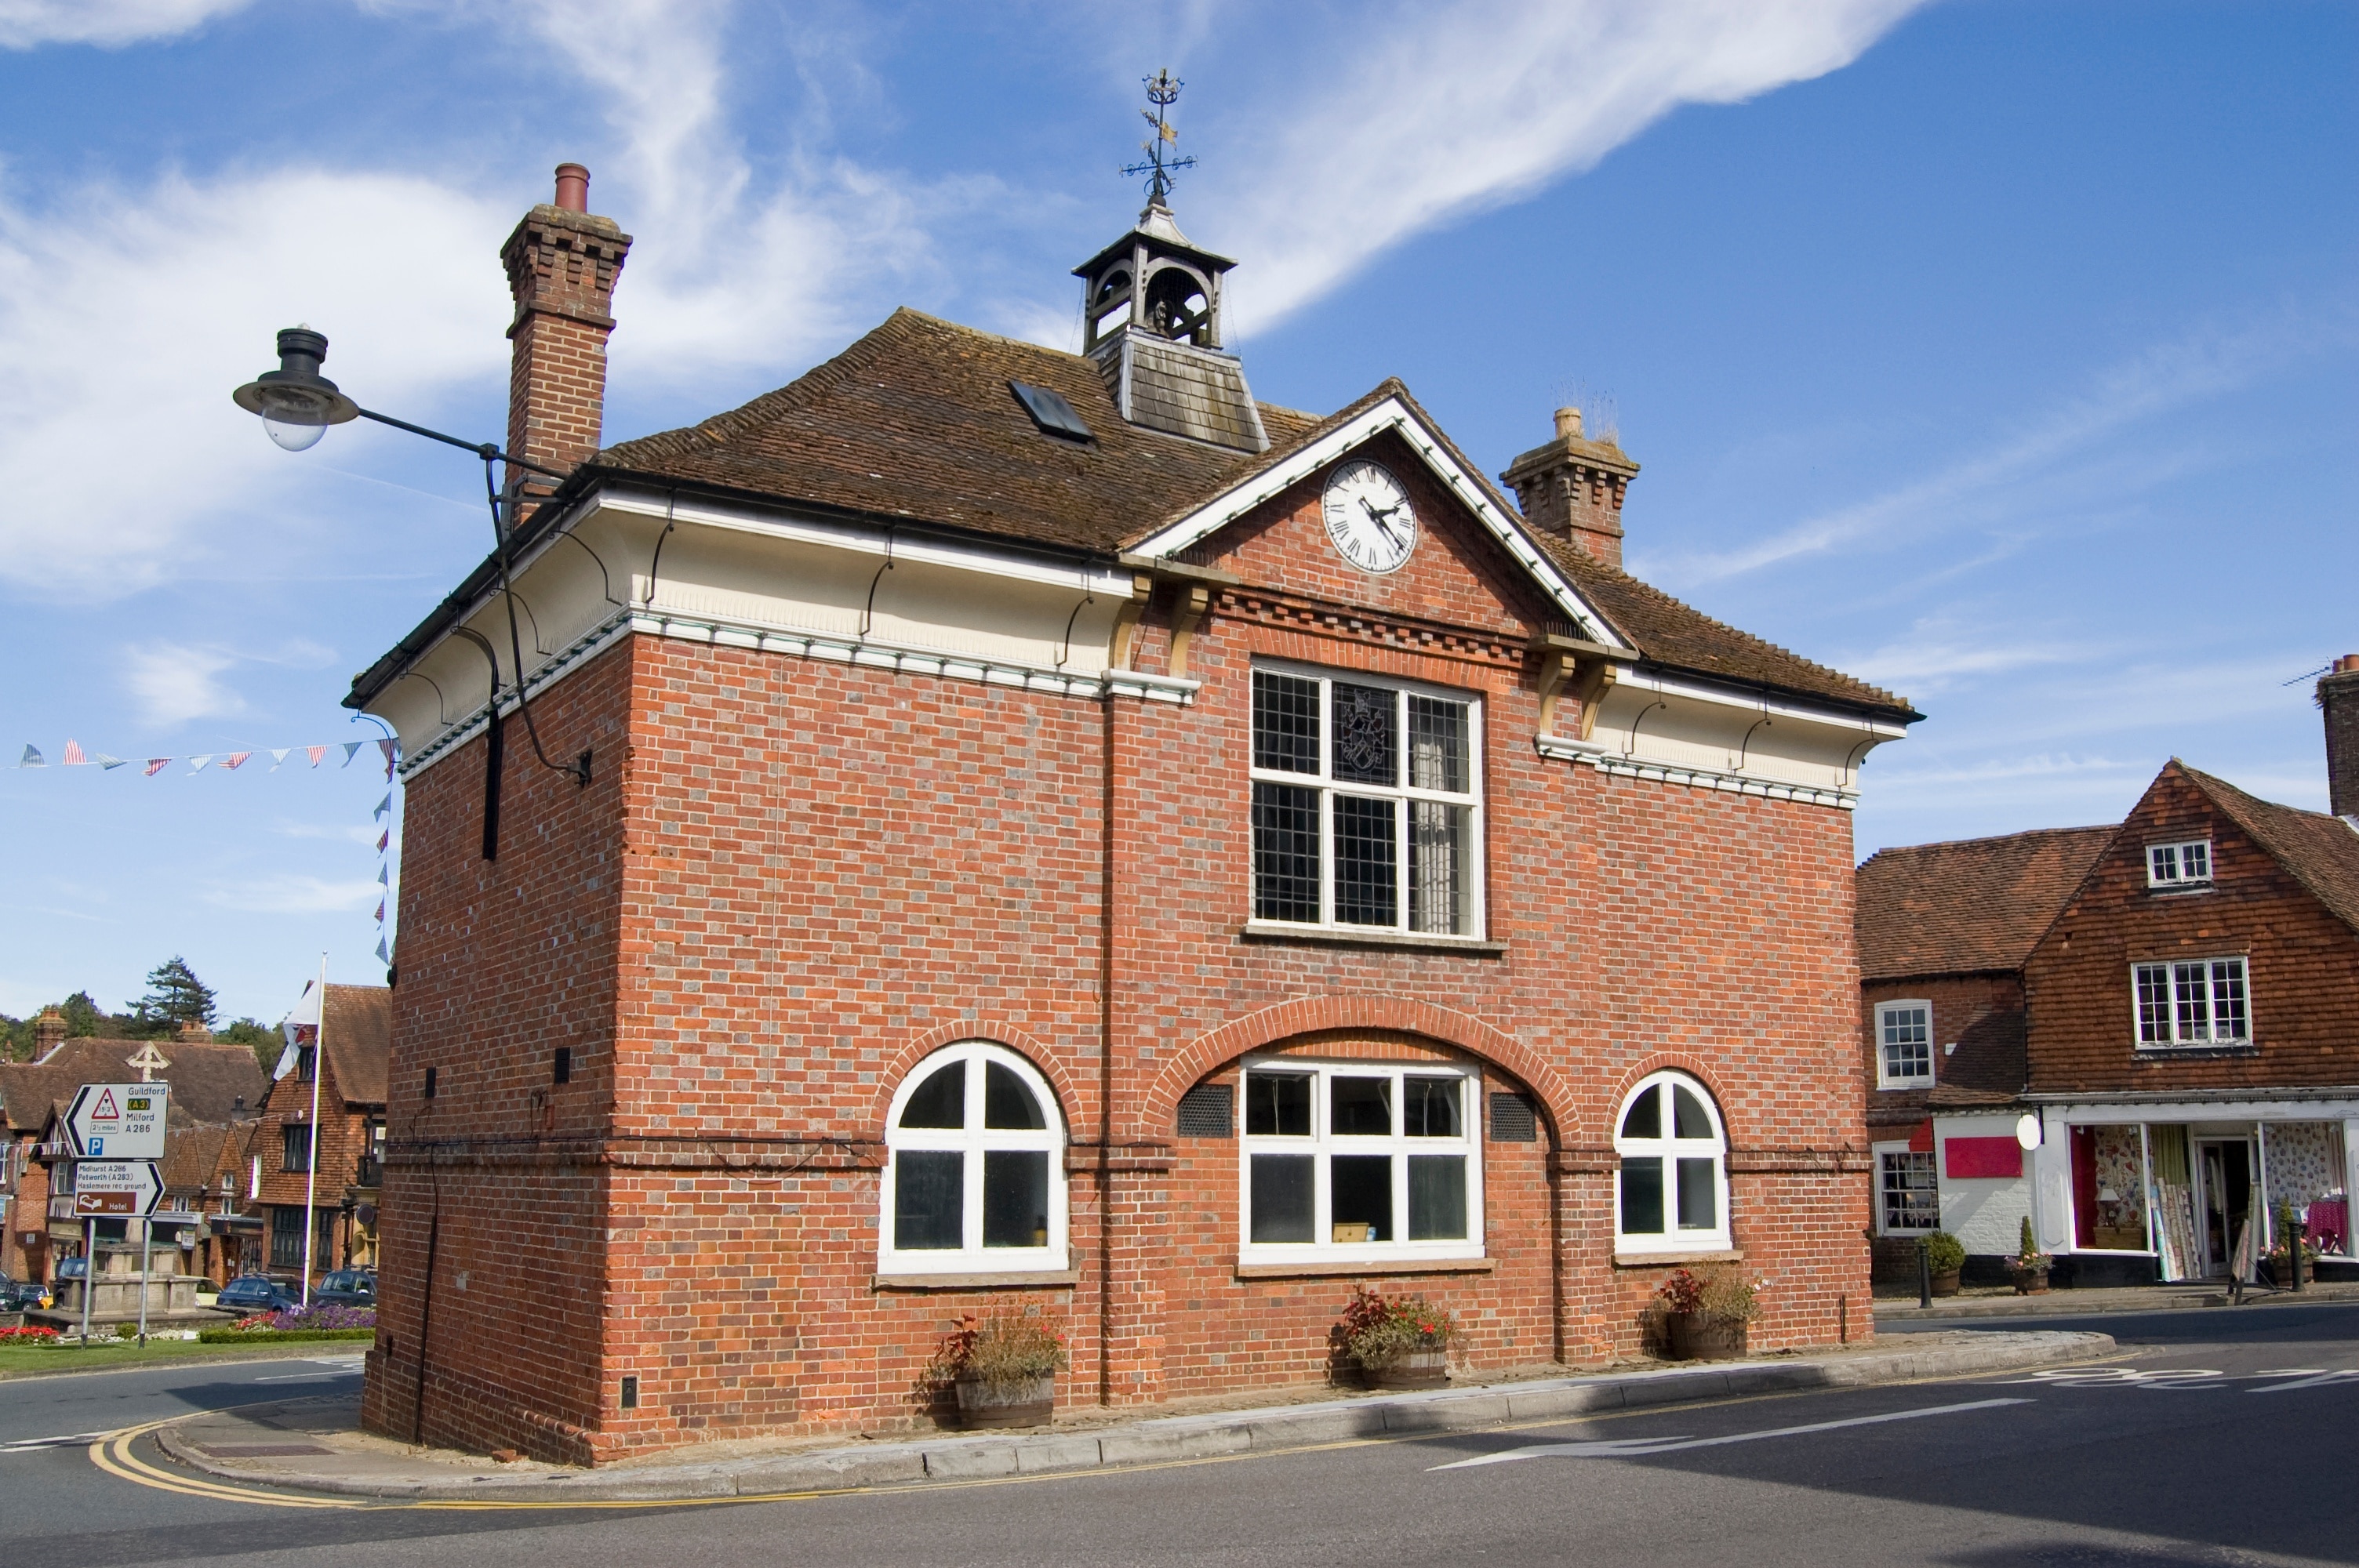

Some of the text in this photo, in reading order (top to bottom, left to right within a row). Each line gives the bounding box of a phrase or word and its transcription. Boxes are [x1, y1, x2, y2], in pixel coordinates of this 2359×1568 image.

[128, 1087, 165, 1095] Guildford
[129, 1100, 149, 1109] (A3)
[91, 1139, 100, 1154] P
